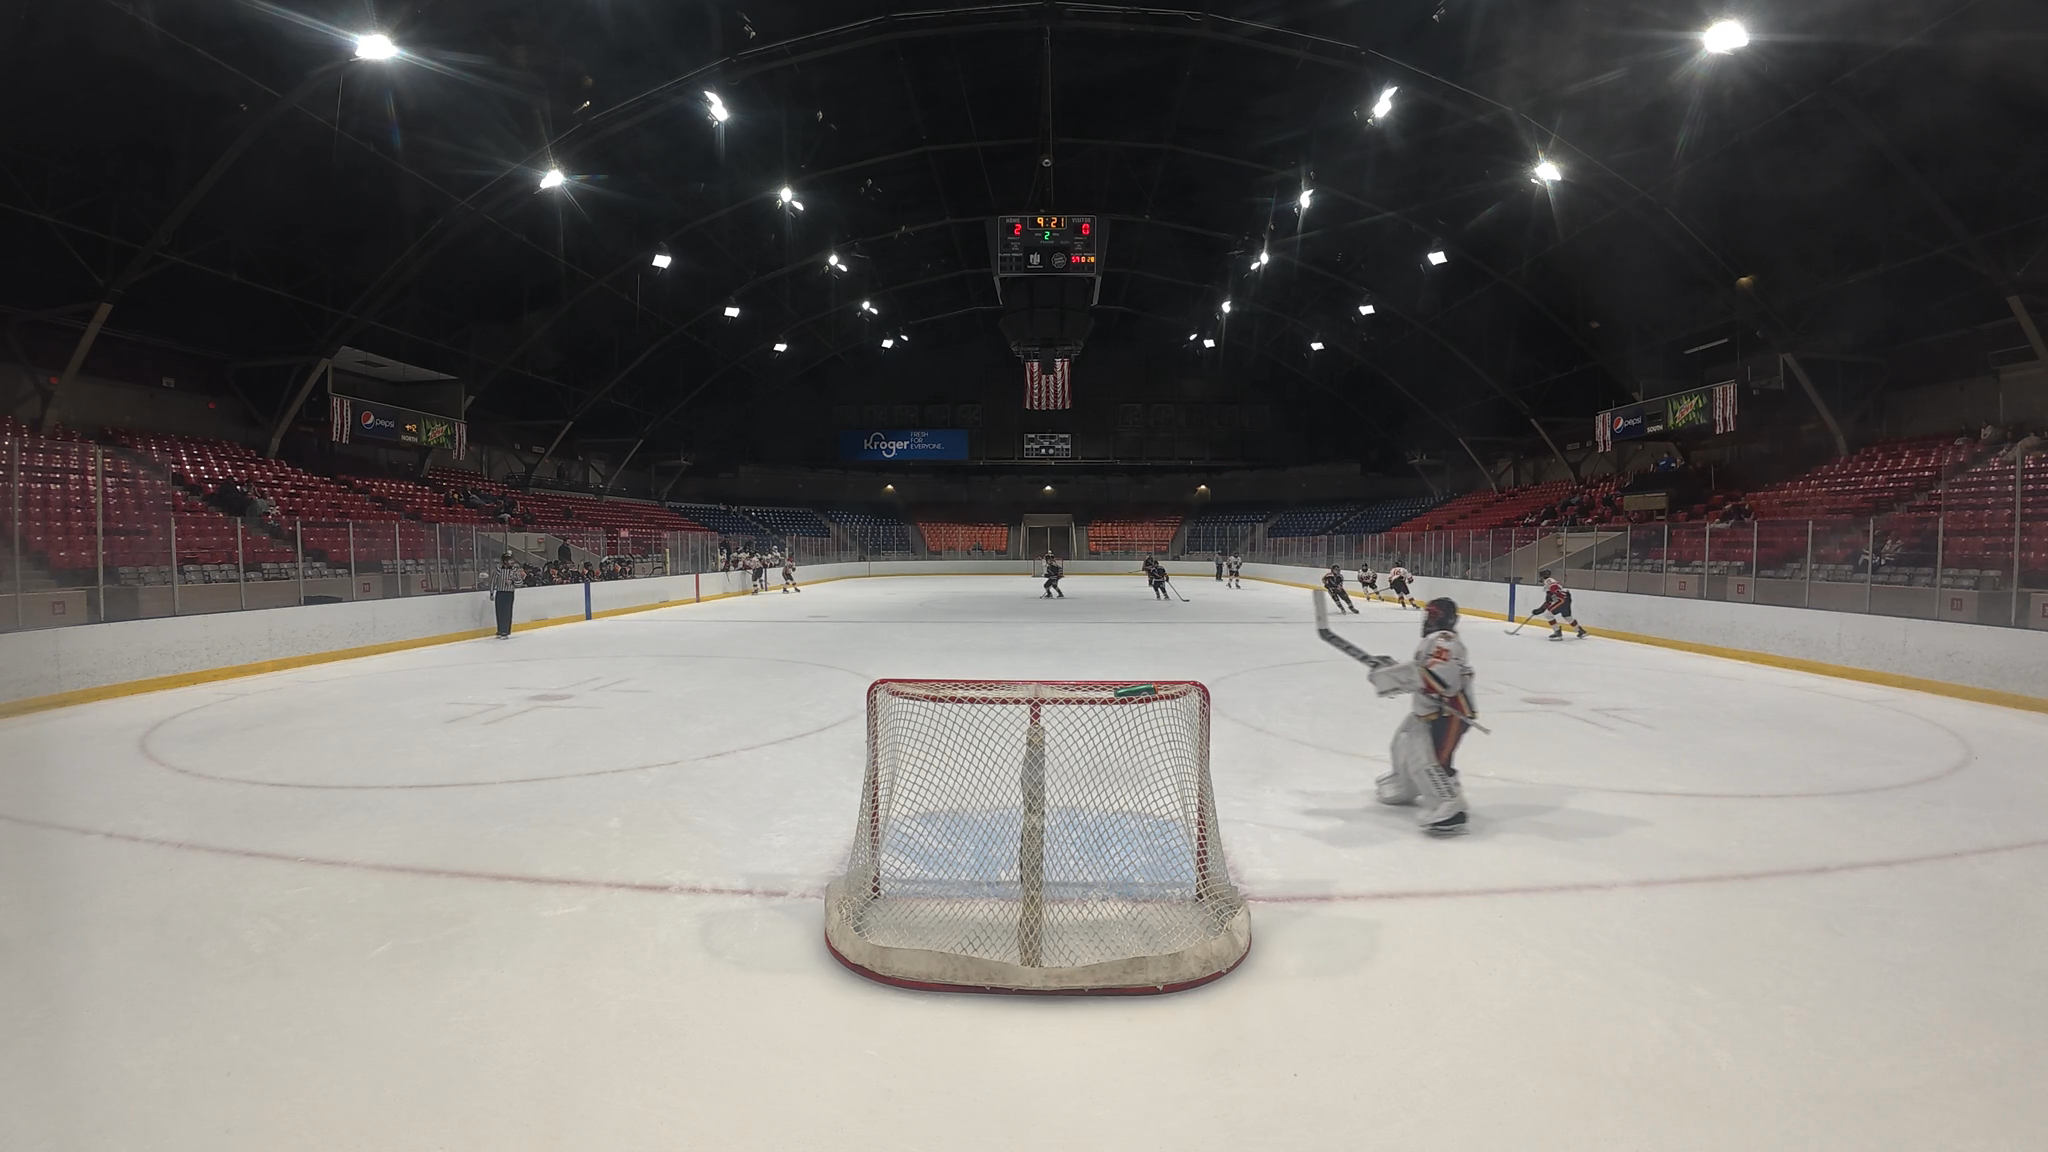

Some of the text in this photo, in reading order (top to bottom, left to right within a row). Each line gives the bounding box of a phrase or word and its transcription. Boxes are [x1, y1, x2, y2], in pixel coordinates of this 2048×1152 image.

[1037, 217, 1065, 228] 9:21
[1013, 223, 1022, 235] 2
[1082, 223, 1090, 235] 0
[1044, 231, 1051, 240] 2
[375, 418, 395, 428] pepsi
[1623, 415, 1642, 428] pepsi
[1646, 424, 1664, 433] SOUTH
[864, 432, 910, 458] Kroger
